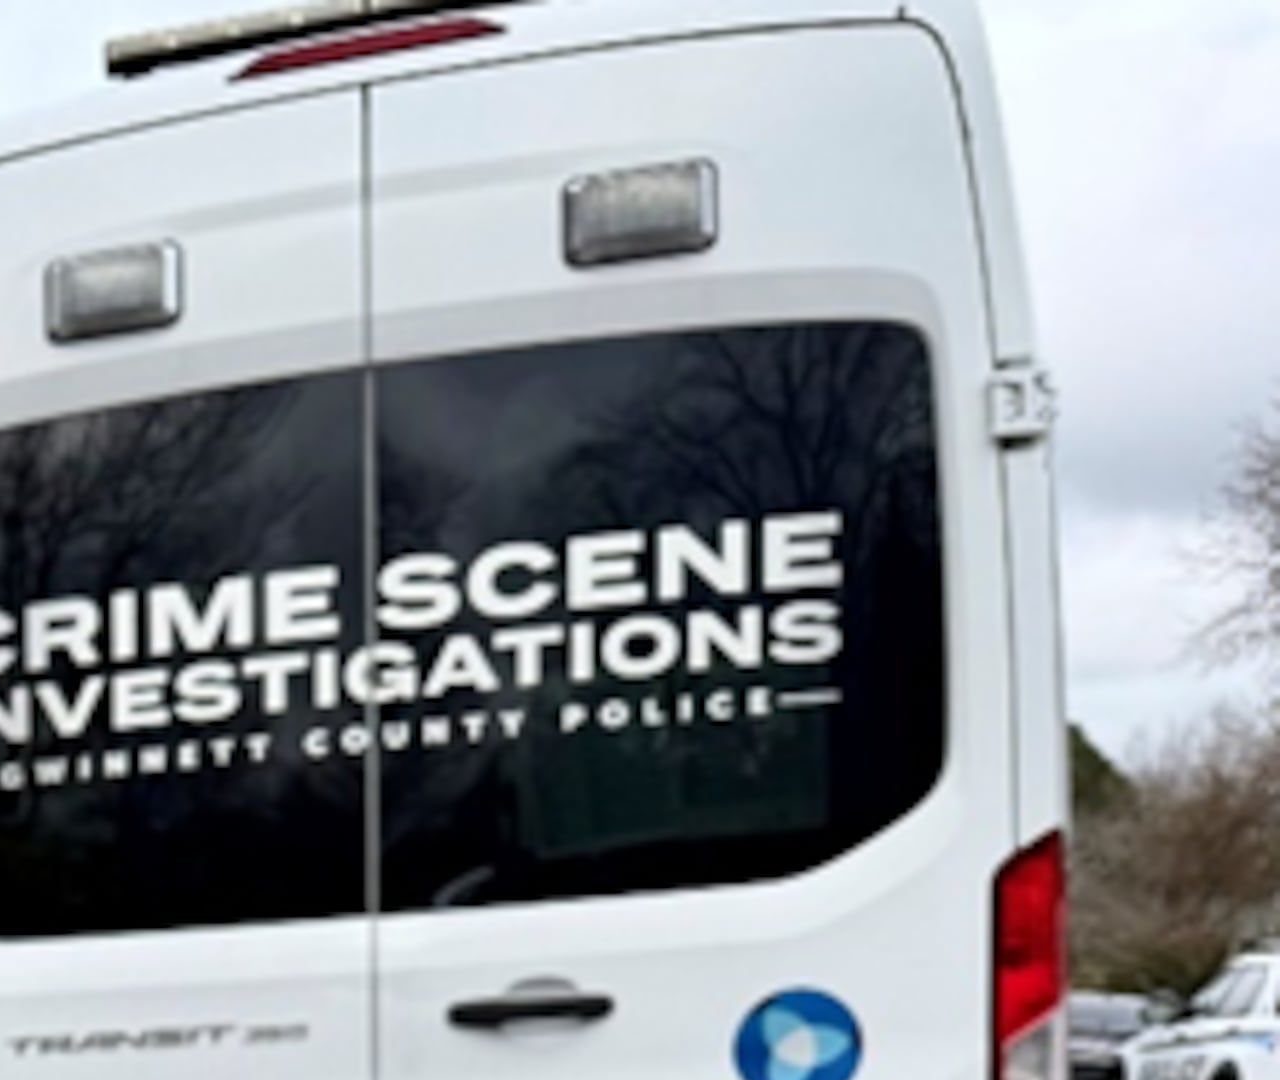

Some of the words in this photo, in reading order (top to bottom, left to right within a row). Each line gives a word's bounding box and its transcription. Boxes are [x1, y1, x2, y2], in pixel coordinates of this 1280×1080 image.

[373, 512, 843, 630] SCENE
[302, 708, 526, 758] COUNTY
[560, 685, 771, 732] POLICE
[6, 1024, 236, 1058] TRANSIT
